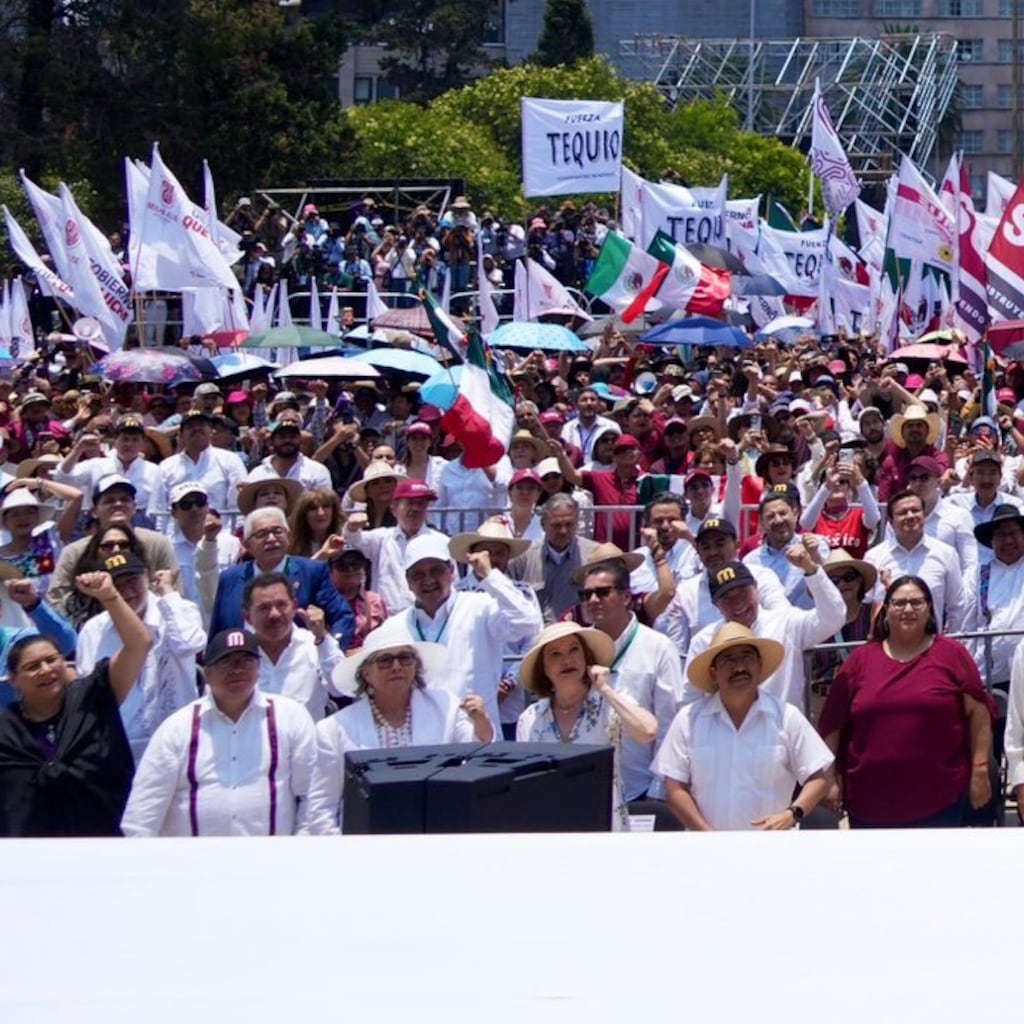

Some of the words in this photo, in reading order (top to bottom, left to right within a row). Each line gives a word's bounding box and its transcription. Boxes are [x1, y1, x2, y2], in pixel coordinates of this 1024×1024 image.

[565, 113, 601, 124] FUERZA
[546, 129, 620, 169] TEQUIO
[182, 215, 209, 238] QUE
